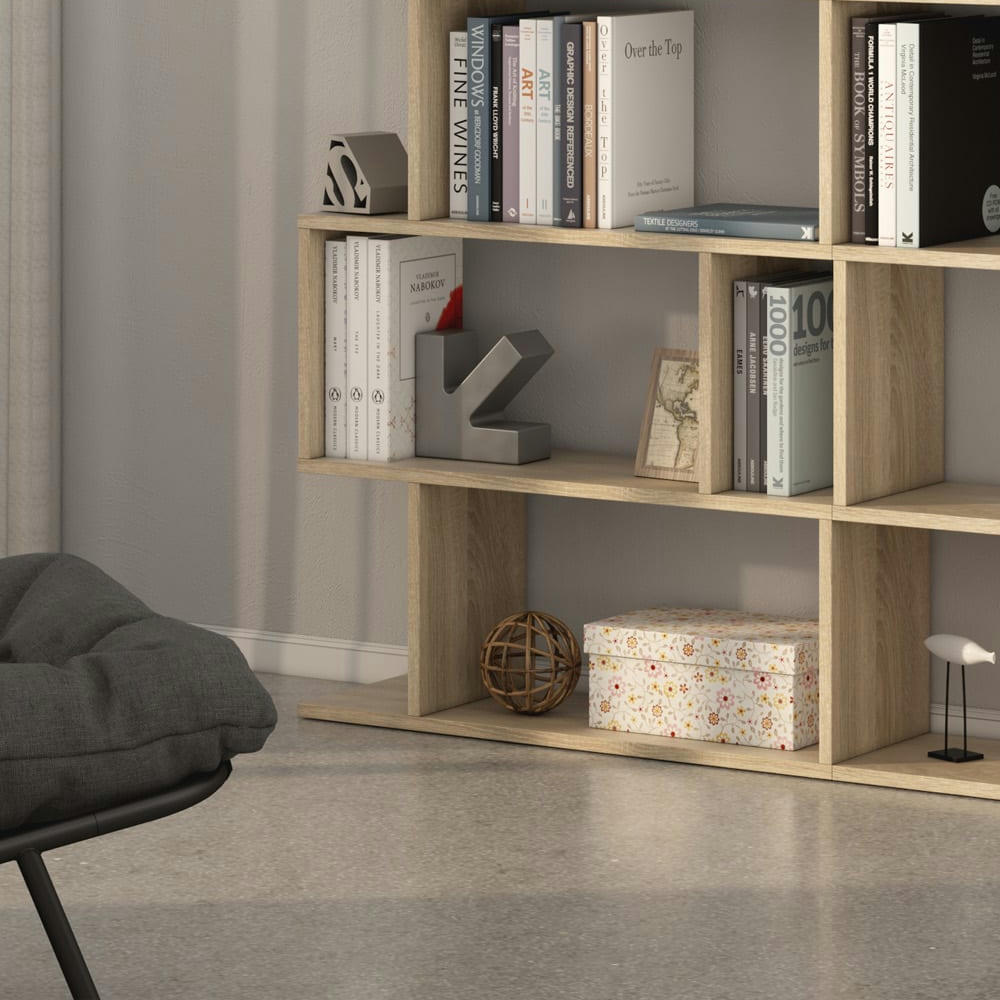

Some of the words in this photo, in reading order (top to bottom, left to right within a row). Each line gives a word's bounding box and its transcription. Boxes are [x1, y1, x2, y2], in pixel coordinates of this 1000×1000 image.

[471, 24, 484, 107] WINDOWS
[566, 42, 575, 84] GRAPHIC
[624, 41, 647, 60] Over
[648, 40, 662, 56] the
[664, 38, 683, 60] Top
[454, 58, 468, 108] FINE
[522, 68, 534, 100] ART
[539, 68, 550, 101] ART
[566, 87, 575, 122] DESIGN
[854, 71, 865, 116] BOOK
[906, 70, 915, 116] Contemporary
[584, 104, 592, 158] BORDEAUX
[884, 80, 894, 190] ANTIQUAIRES
[454, 118, 468, 194] WINES
[566, 125, 575, 188] REFERENCED
[854, 132, 866, 213] SYMBOLS
[644, 217, 666, 226] TEXTILE
[666, 218, 699, 228] DESIGNERS
[410, 278, 446, 292] NABOKOV
[769, 295, 786, 356] 1000
[793, 341, 818, 358] designs
[820, 338, 829, 352] for
